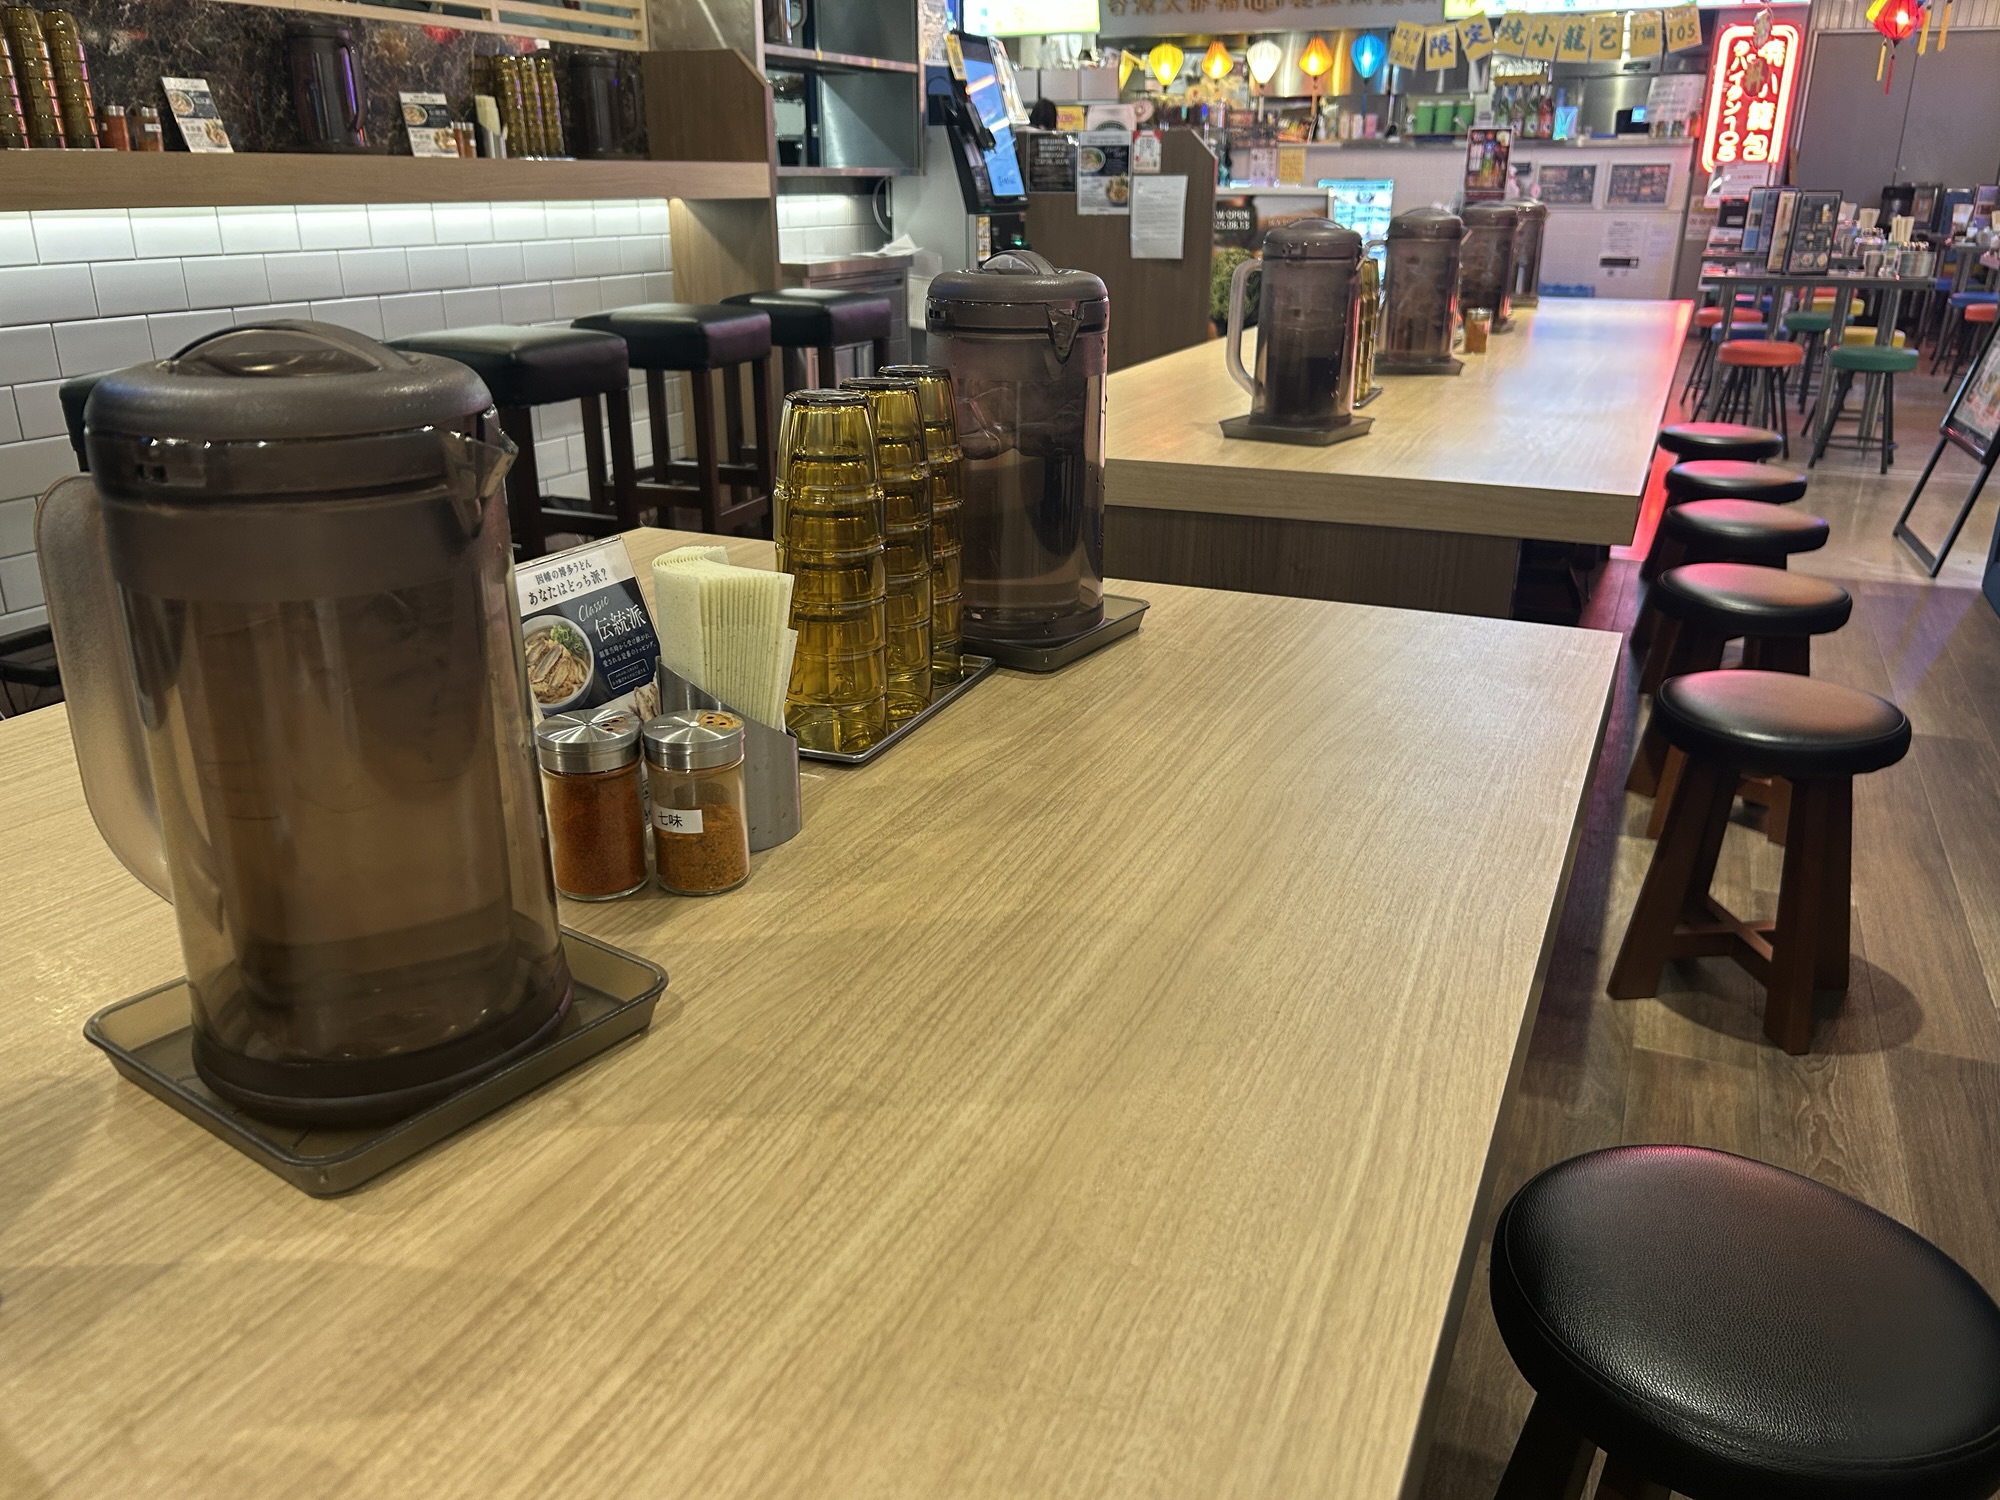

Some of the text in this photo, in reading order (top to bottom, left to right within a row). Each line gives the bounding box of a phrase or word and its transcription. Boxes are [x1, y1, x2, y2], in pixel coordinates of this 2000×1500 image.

[578, 595, 610, 623] Classic
[595, 604, 647, 643] 伝統派
[658, 811, 683, 828] 七味
